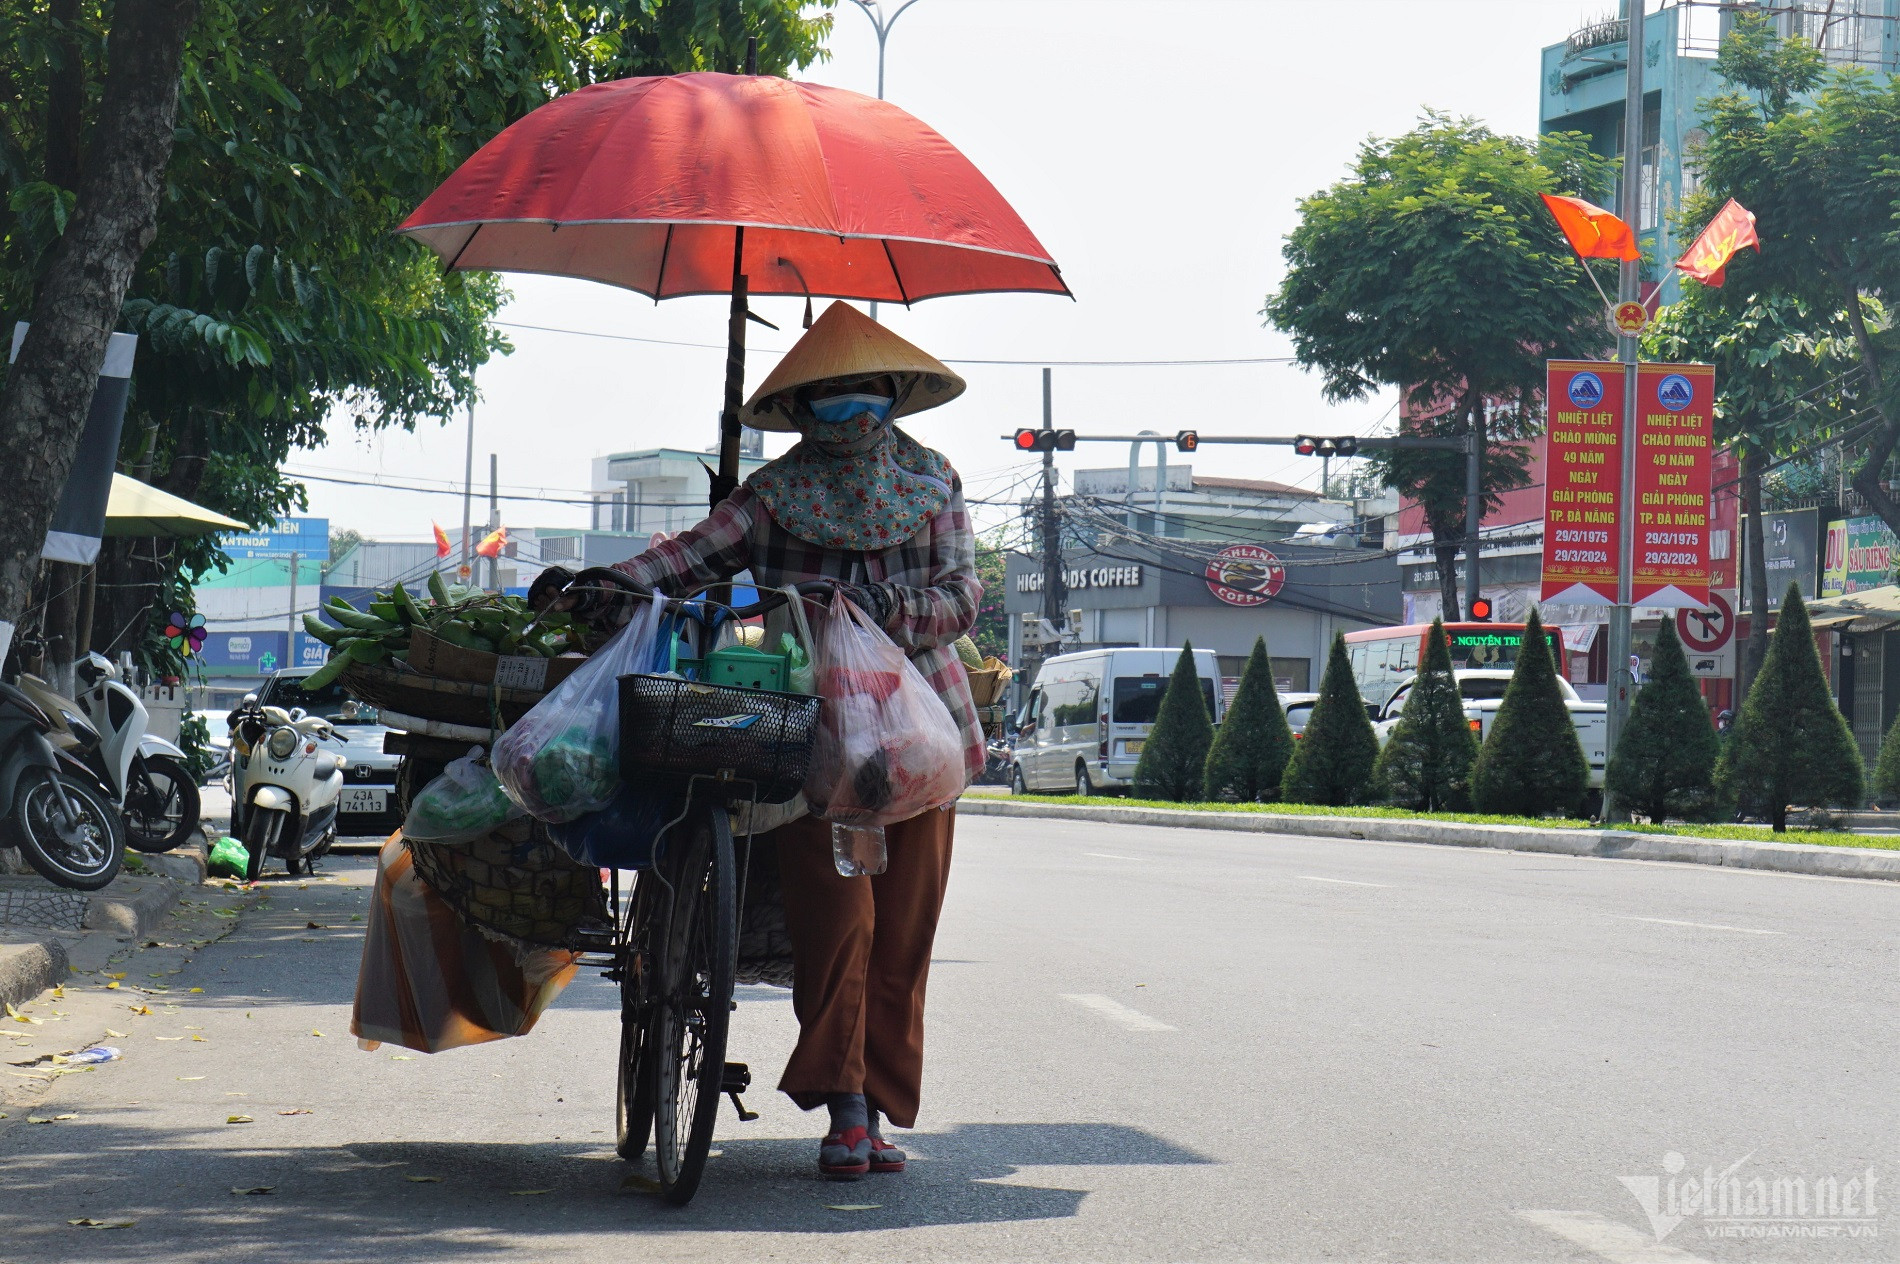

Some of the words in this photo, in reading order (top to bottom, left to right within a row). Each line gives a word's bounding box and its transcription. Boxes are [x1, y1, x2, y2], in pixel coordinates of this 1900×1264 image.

[1557, 411, 1588, 426] NHIỆT
[1591, 411, 1613, 427] LIỆT
[1647, 413, 1678, 428] NHIỆT
[1681, 413, 1702, 429] LIỆT
[1553, 430, 1581, 443] CHÀO
[1584, 431, 1616, 445] MỪNG
[1642, 432, 1671, 446] CHÀO
[1674, 433, 1706, 447] MỪNG
[1563, 452, 1576, 463] 49
[1580, 450, 1604, 464] NĂM
[1653, 454, 1666, 465] 49
[1669, 452, 1694, 466] NĂM
[1569, 470, 1597, 483] NGÀY
[1659, 472, 1687, 485] NGÀY
[1552, 487, 1574, 502] GIẢI
[1577, 490, 1613, 504] PHÓNG
[1642, 490, 1663, 504] GIẢI
[1667, 492, 1703, 506] PHÓNG
[1550, 510, 1564, 521] TP.
[1567, 509, 1581, 522] ĐÀ
[1640, 513, 1654, 524] TP.
[1657, 511, 1671, 524] ĐÀ
[1555, 530, 1608, 543] 29/3/1975
[1645, 532, 1698, 545] 29/3/1975
[1555, 550, 1607, 563] 29/3/2024
[1645, 552, 1698, 565] 29/3/2024
[1090, 566, 1139, 587] COFFEE
[303, 644, 323, 660] GIÁ
[354, 790, 373, 801] 43A
[345, 802, 382, 811] 741.13
